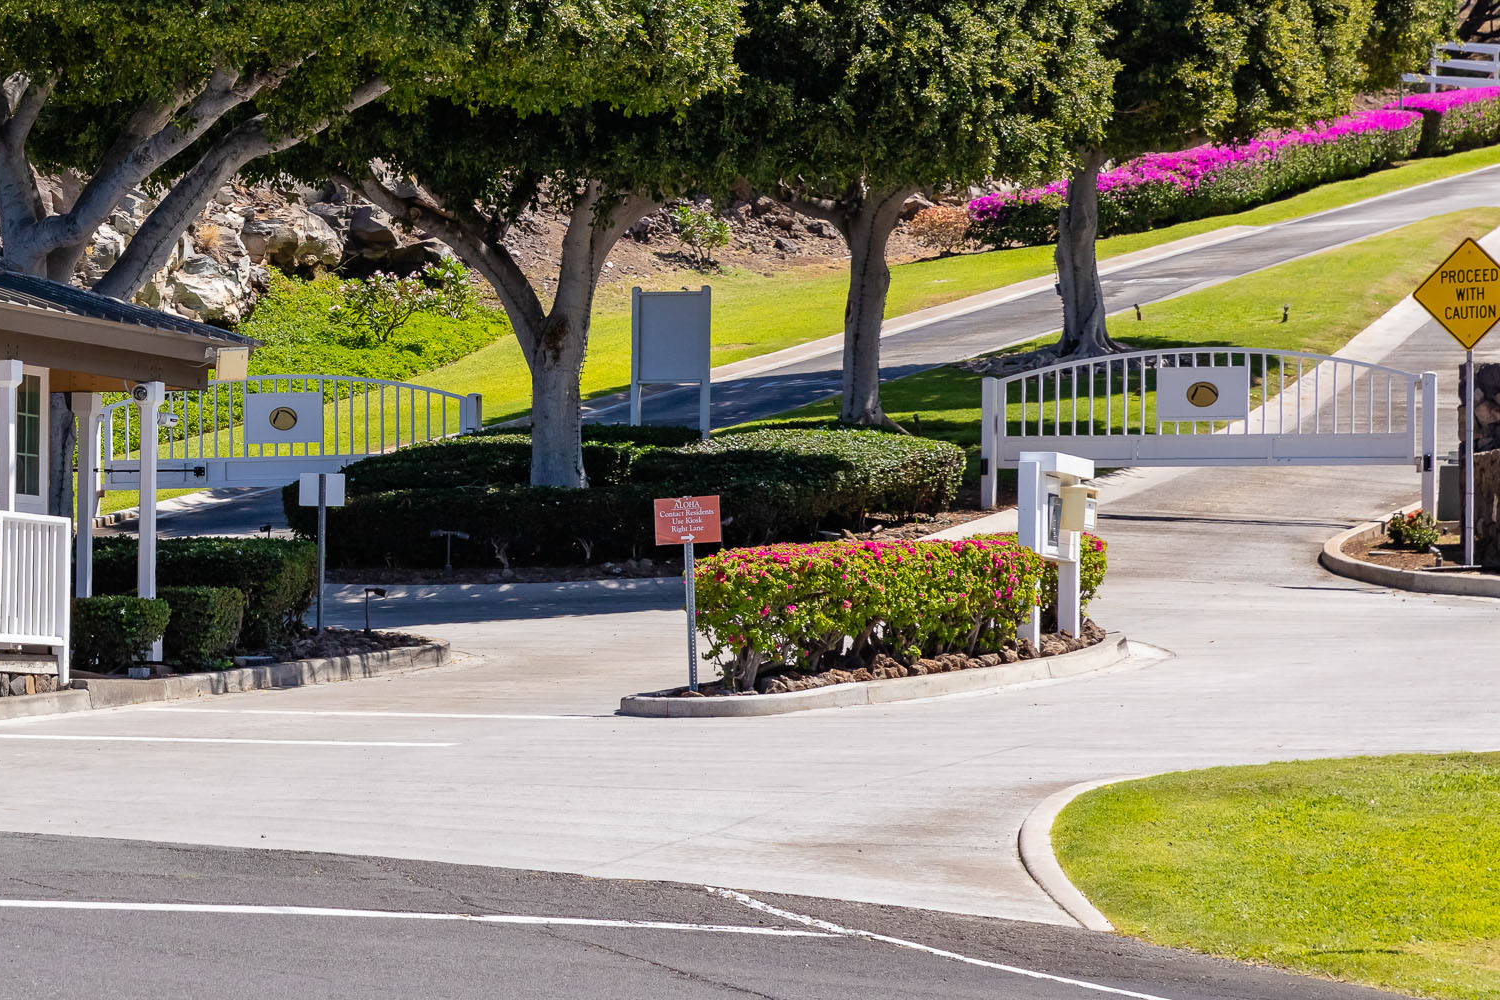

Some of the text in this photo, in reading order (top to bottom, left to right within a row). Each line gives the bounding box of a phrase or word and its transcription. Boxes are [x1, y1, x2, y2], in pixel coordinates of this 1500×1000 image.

[1440, 268, 1499, 284] PROCEED
[1455, 286, 1485, 301] WITH
[1444, 304, 1496, 320] CAUTION
[673, 501, 700, 509] ALOHA
[659, 508, 714, 518] Contact Residents
[685, 516, 703, 524] Kiosk
[671, 524, 704, 533] Right Lane
